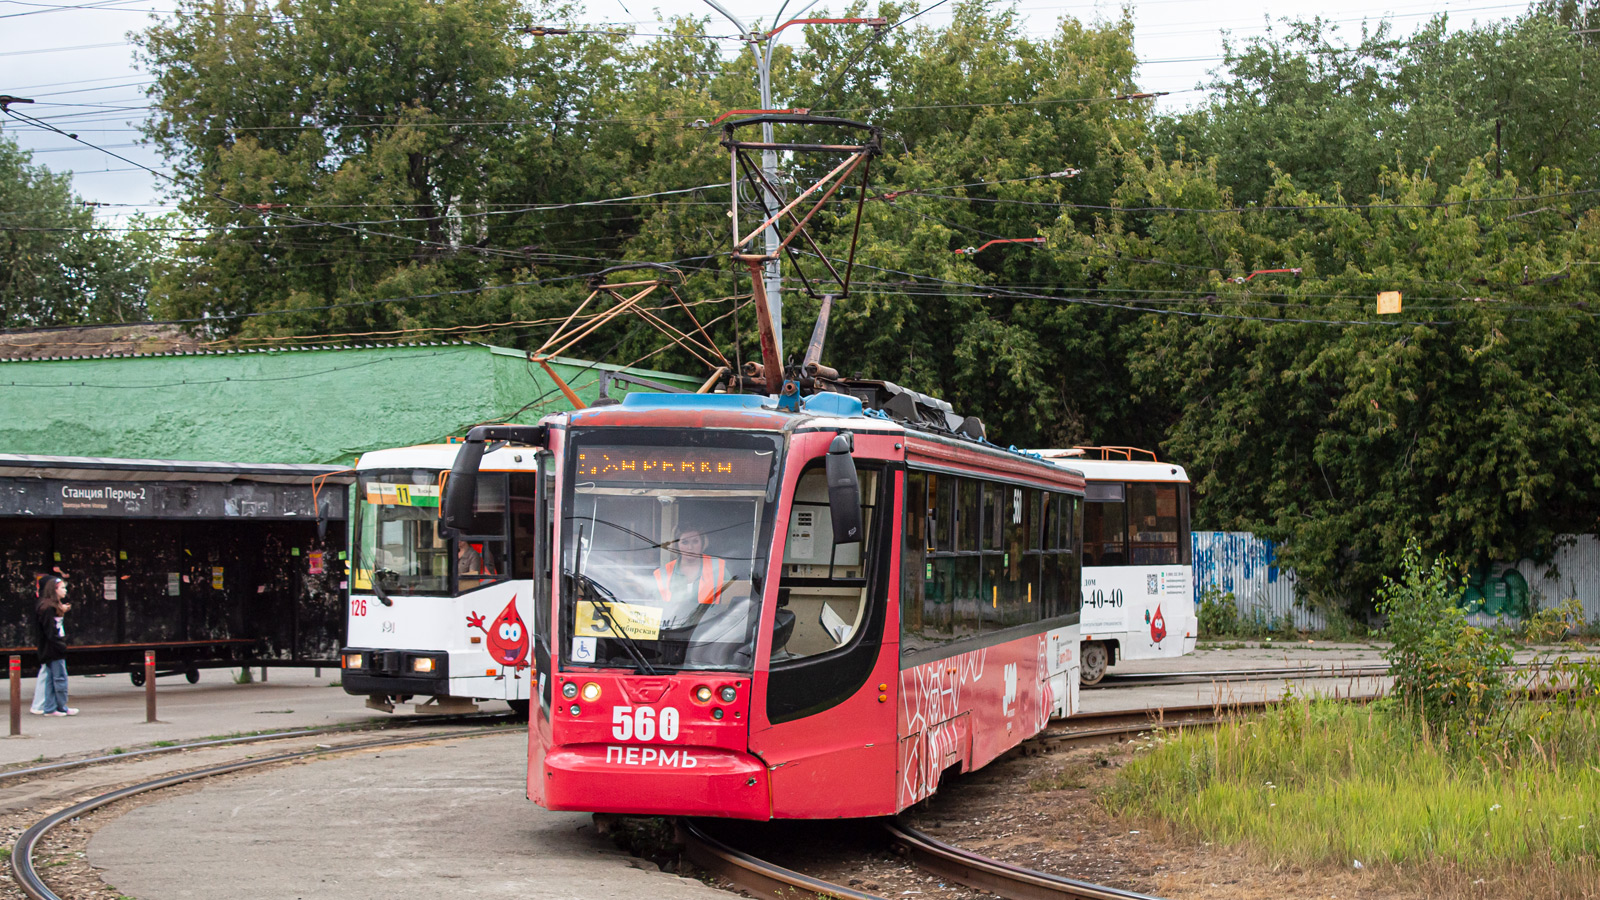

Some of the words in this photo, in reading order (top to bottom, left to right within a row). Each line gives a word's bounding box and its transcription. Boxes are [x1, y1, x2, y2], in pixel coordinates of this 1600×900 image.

[61, 485, 103, 500] Станция
[105, 486, 146, 502] Пермь-2
[397, 487, 409, 504] 11
[351, 599, 367, 616] 126
[590, 606, 612, 633] 5
[612, 705, 679, 741] 560
[606, 746, 697, 768] ПЕРМЬ
